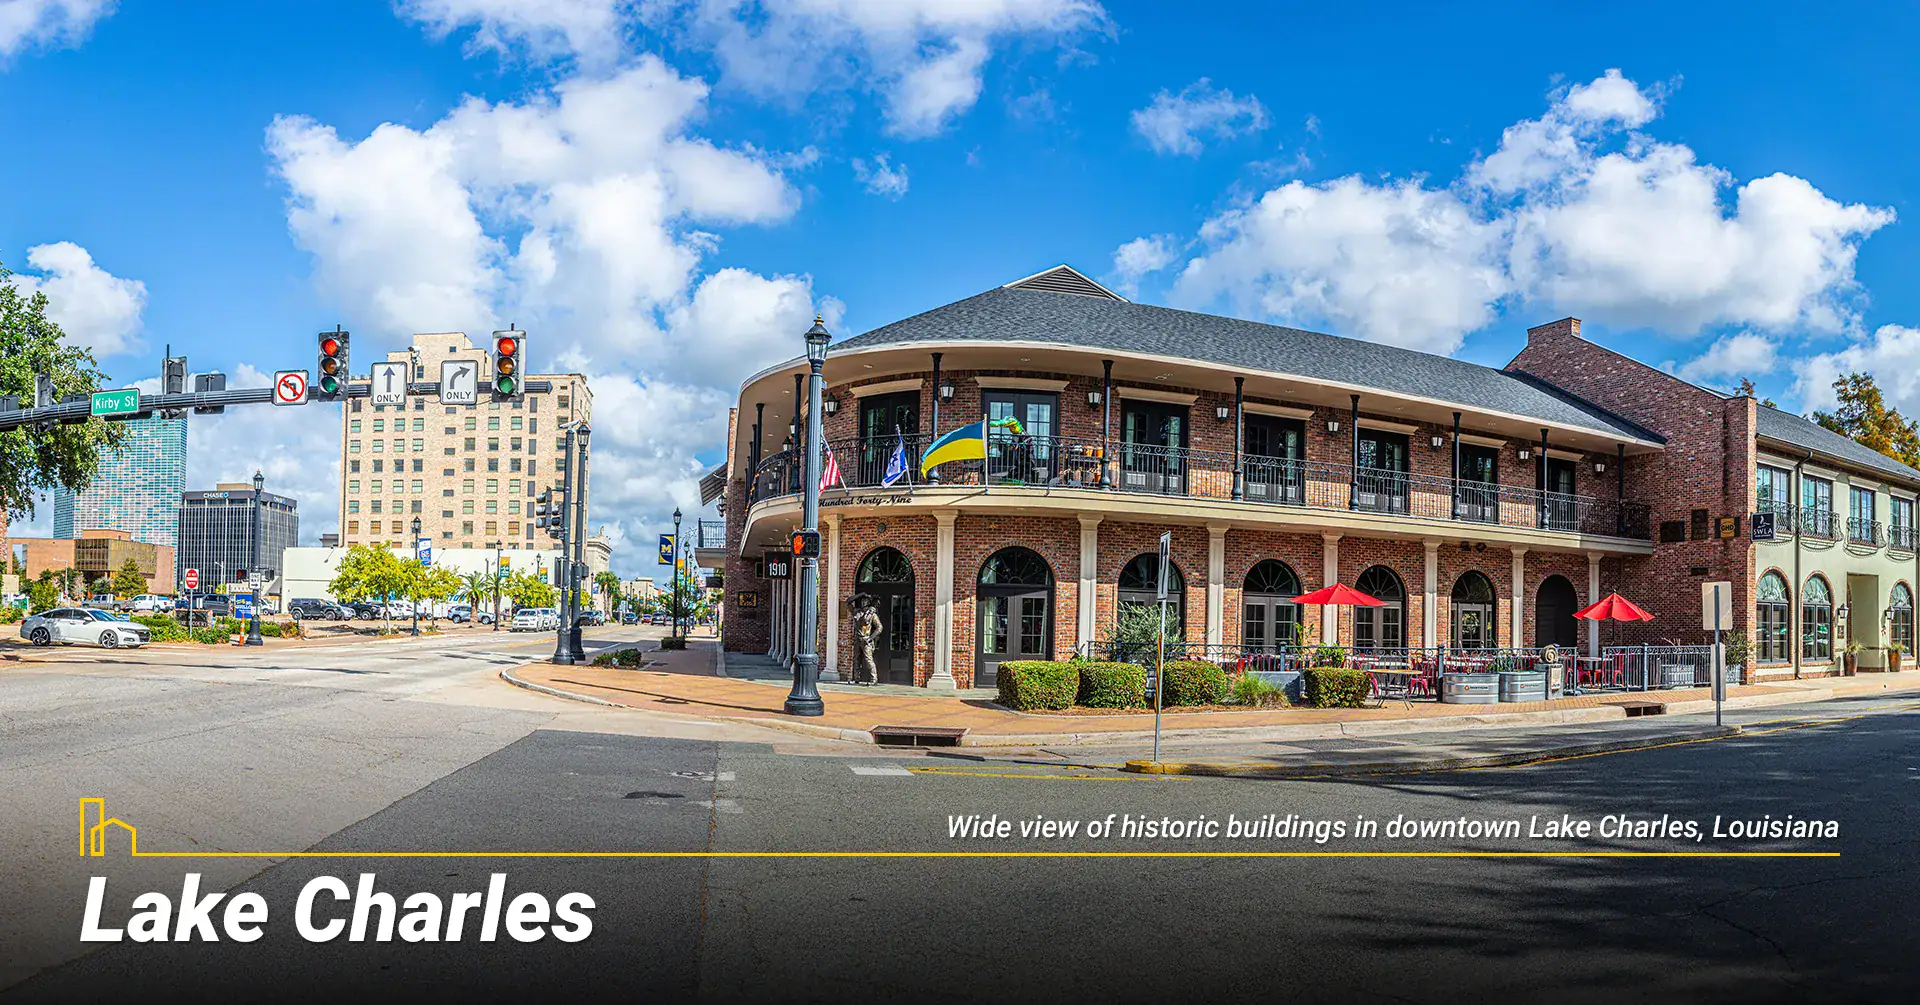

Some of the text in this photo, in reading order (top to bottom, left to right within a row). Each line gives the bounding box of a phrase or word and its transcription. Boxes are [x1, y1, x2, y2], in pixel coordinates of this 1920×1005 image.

[376, 394, 401, 403] ONLY
[446, 391, 472, 400] ONLY
[95, 395, 135, 411] Kirby St
[818, 494, 912, 507] Hundred Forty-Nine
[661, 544, 672, 553] M
[768, 562, 787, 576] 1910
